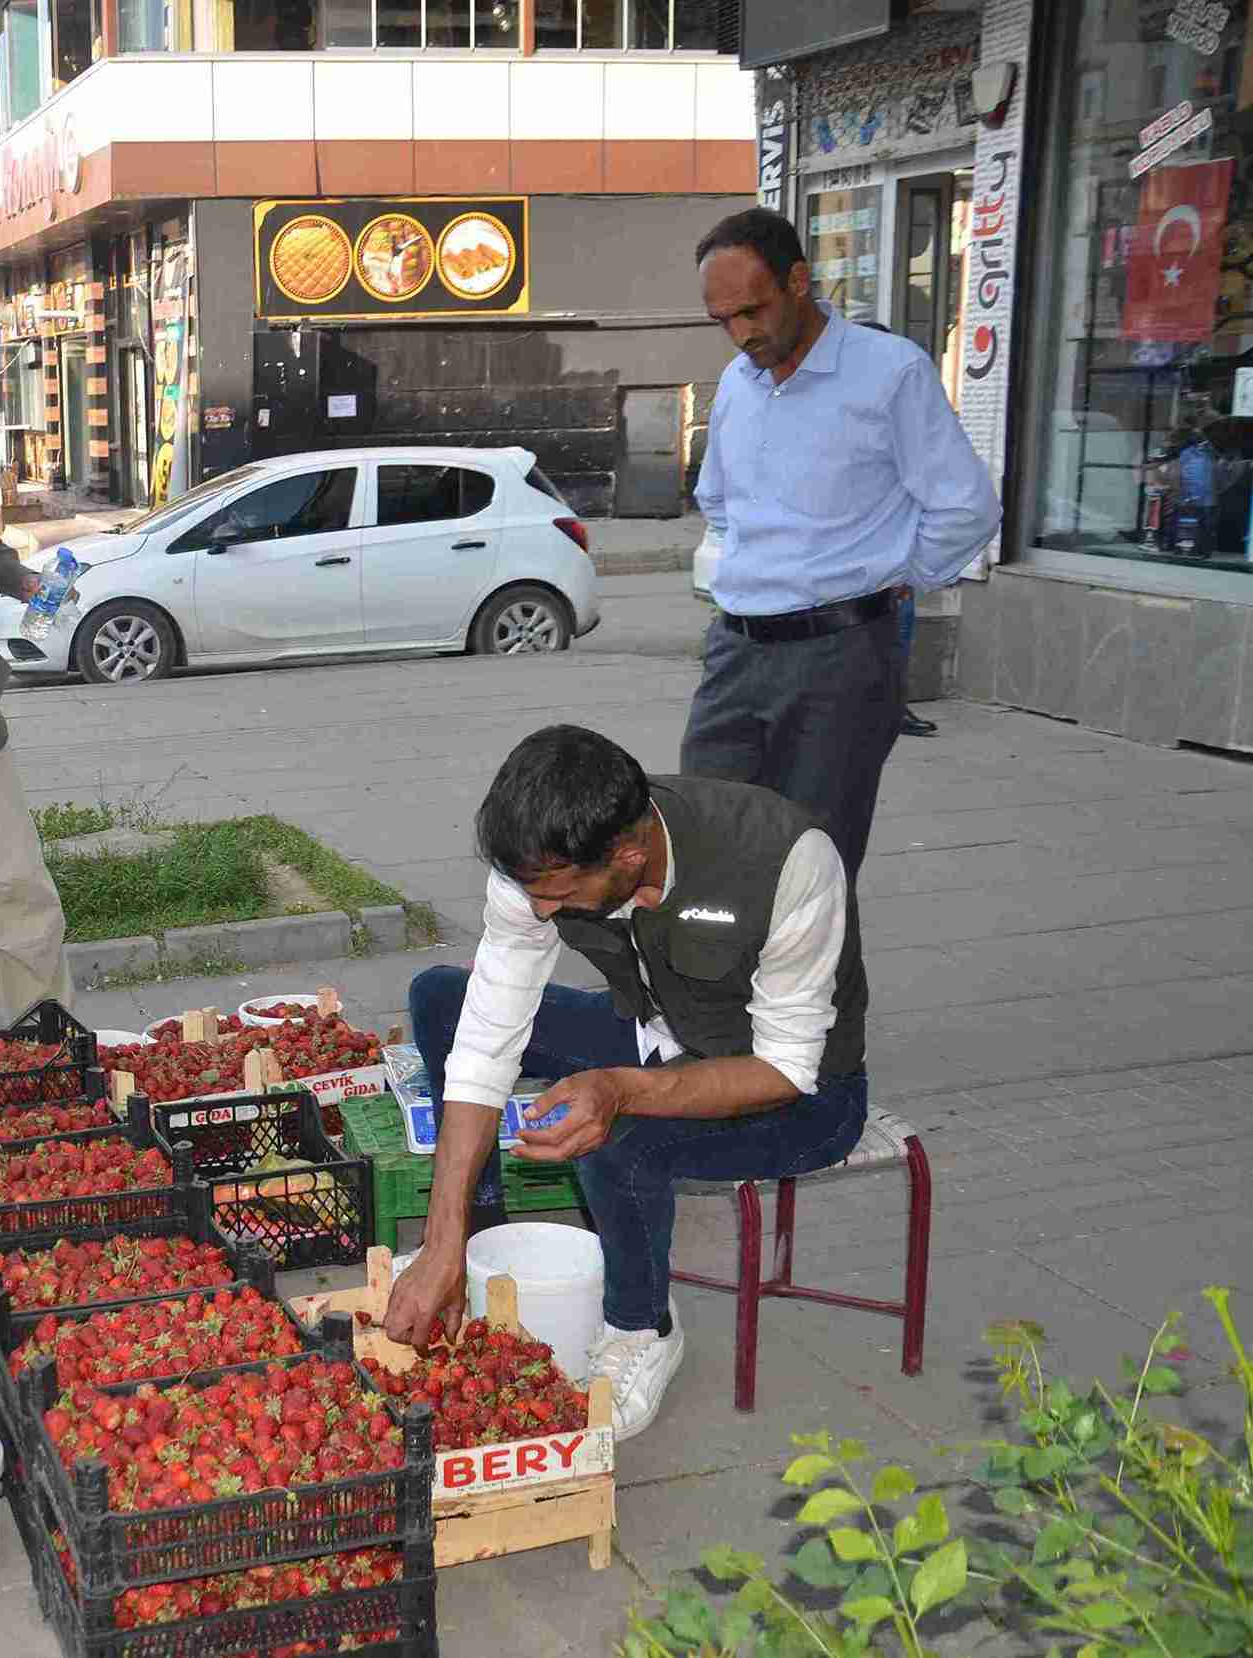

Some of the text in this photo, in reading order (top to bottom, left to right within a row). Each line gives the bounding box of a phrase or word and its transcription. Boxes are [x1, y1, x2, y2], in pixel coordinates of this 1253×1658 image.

[343, 1083, 377, 1098] GIDA
[195, 1109, 232, 1123] GDA
[443, 1434, 584, 1489] BERY
